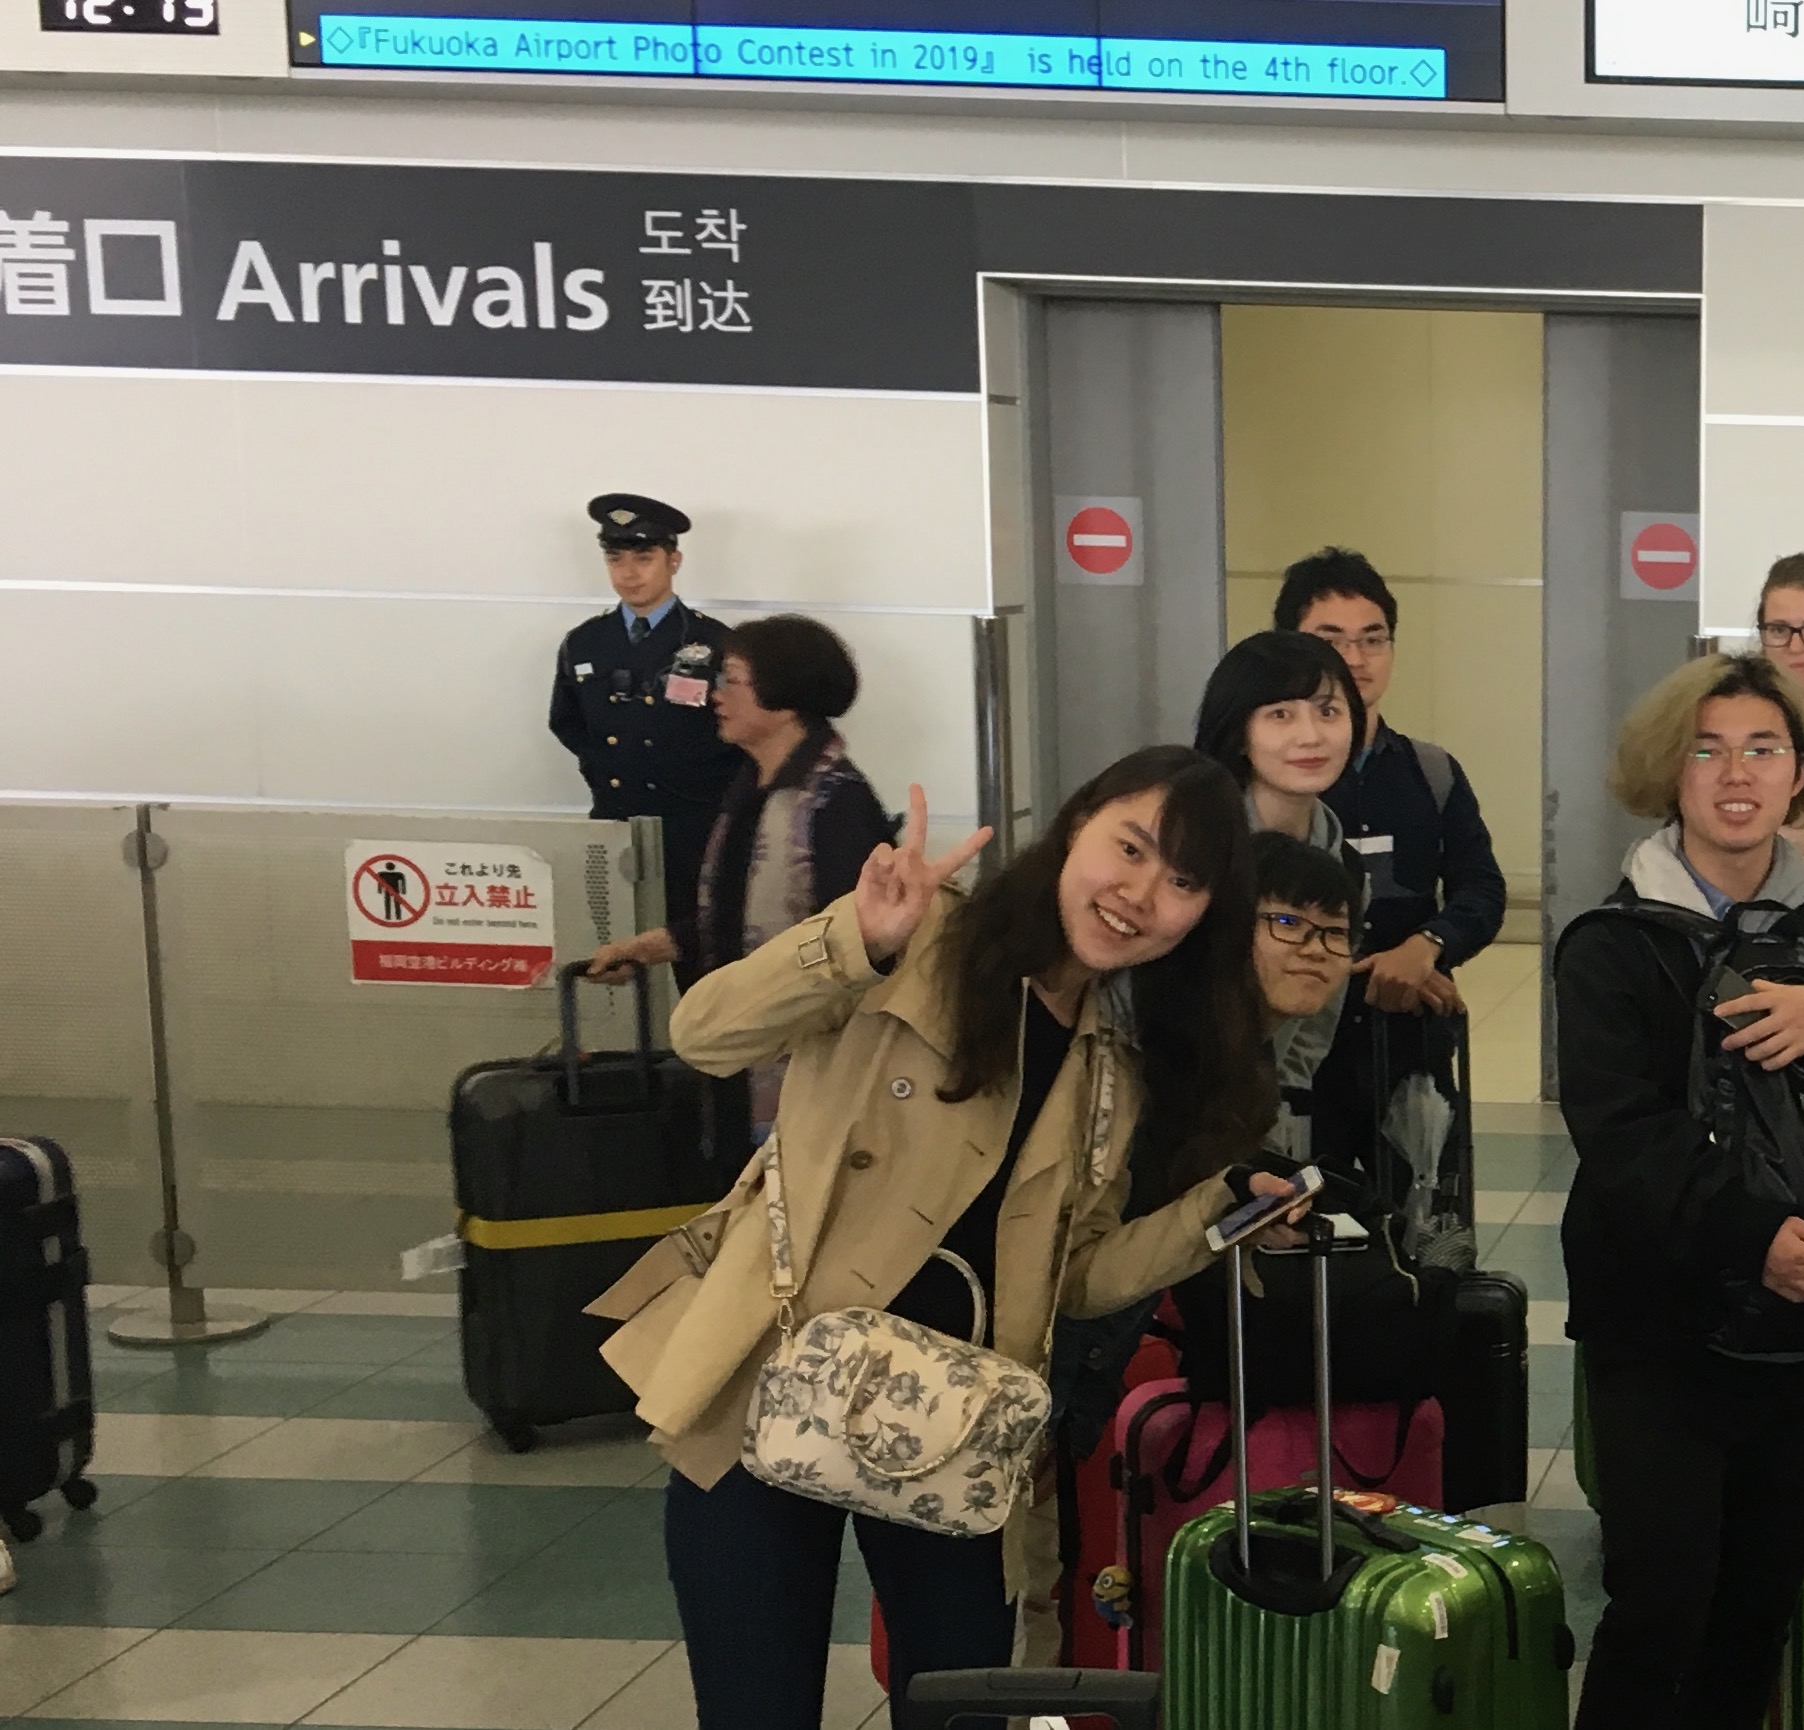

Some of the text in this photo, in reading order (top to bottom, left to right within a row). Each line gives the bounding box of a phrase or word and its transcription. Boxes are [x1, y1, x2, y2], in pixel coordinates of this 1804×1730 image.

[514, 33, 618, 62] Airport
[634, 36, 722, 63] Photo
[737, 39, 854, 68] Contest
[870, 42, 897, 69] in
[1028, 47, 1053, 74] is
[1068, 49, 1131, 77] held
[1148, 57, 1184, 79] on
[1200, 53, 1248, 80] the
[1264, 56, 1310, 83] 4th
[1329, 58, 1407, 86] floor.
[638, 207, 747, 262] 도착
[216, 239, 610, 331] Arrivals
[642, 277, 754, 335] 到达
[435, 883, 537, 909] 立入禁止
[444, 862, 522, 879] これより先
